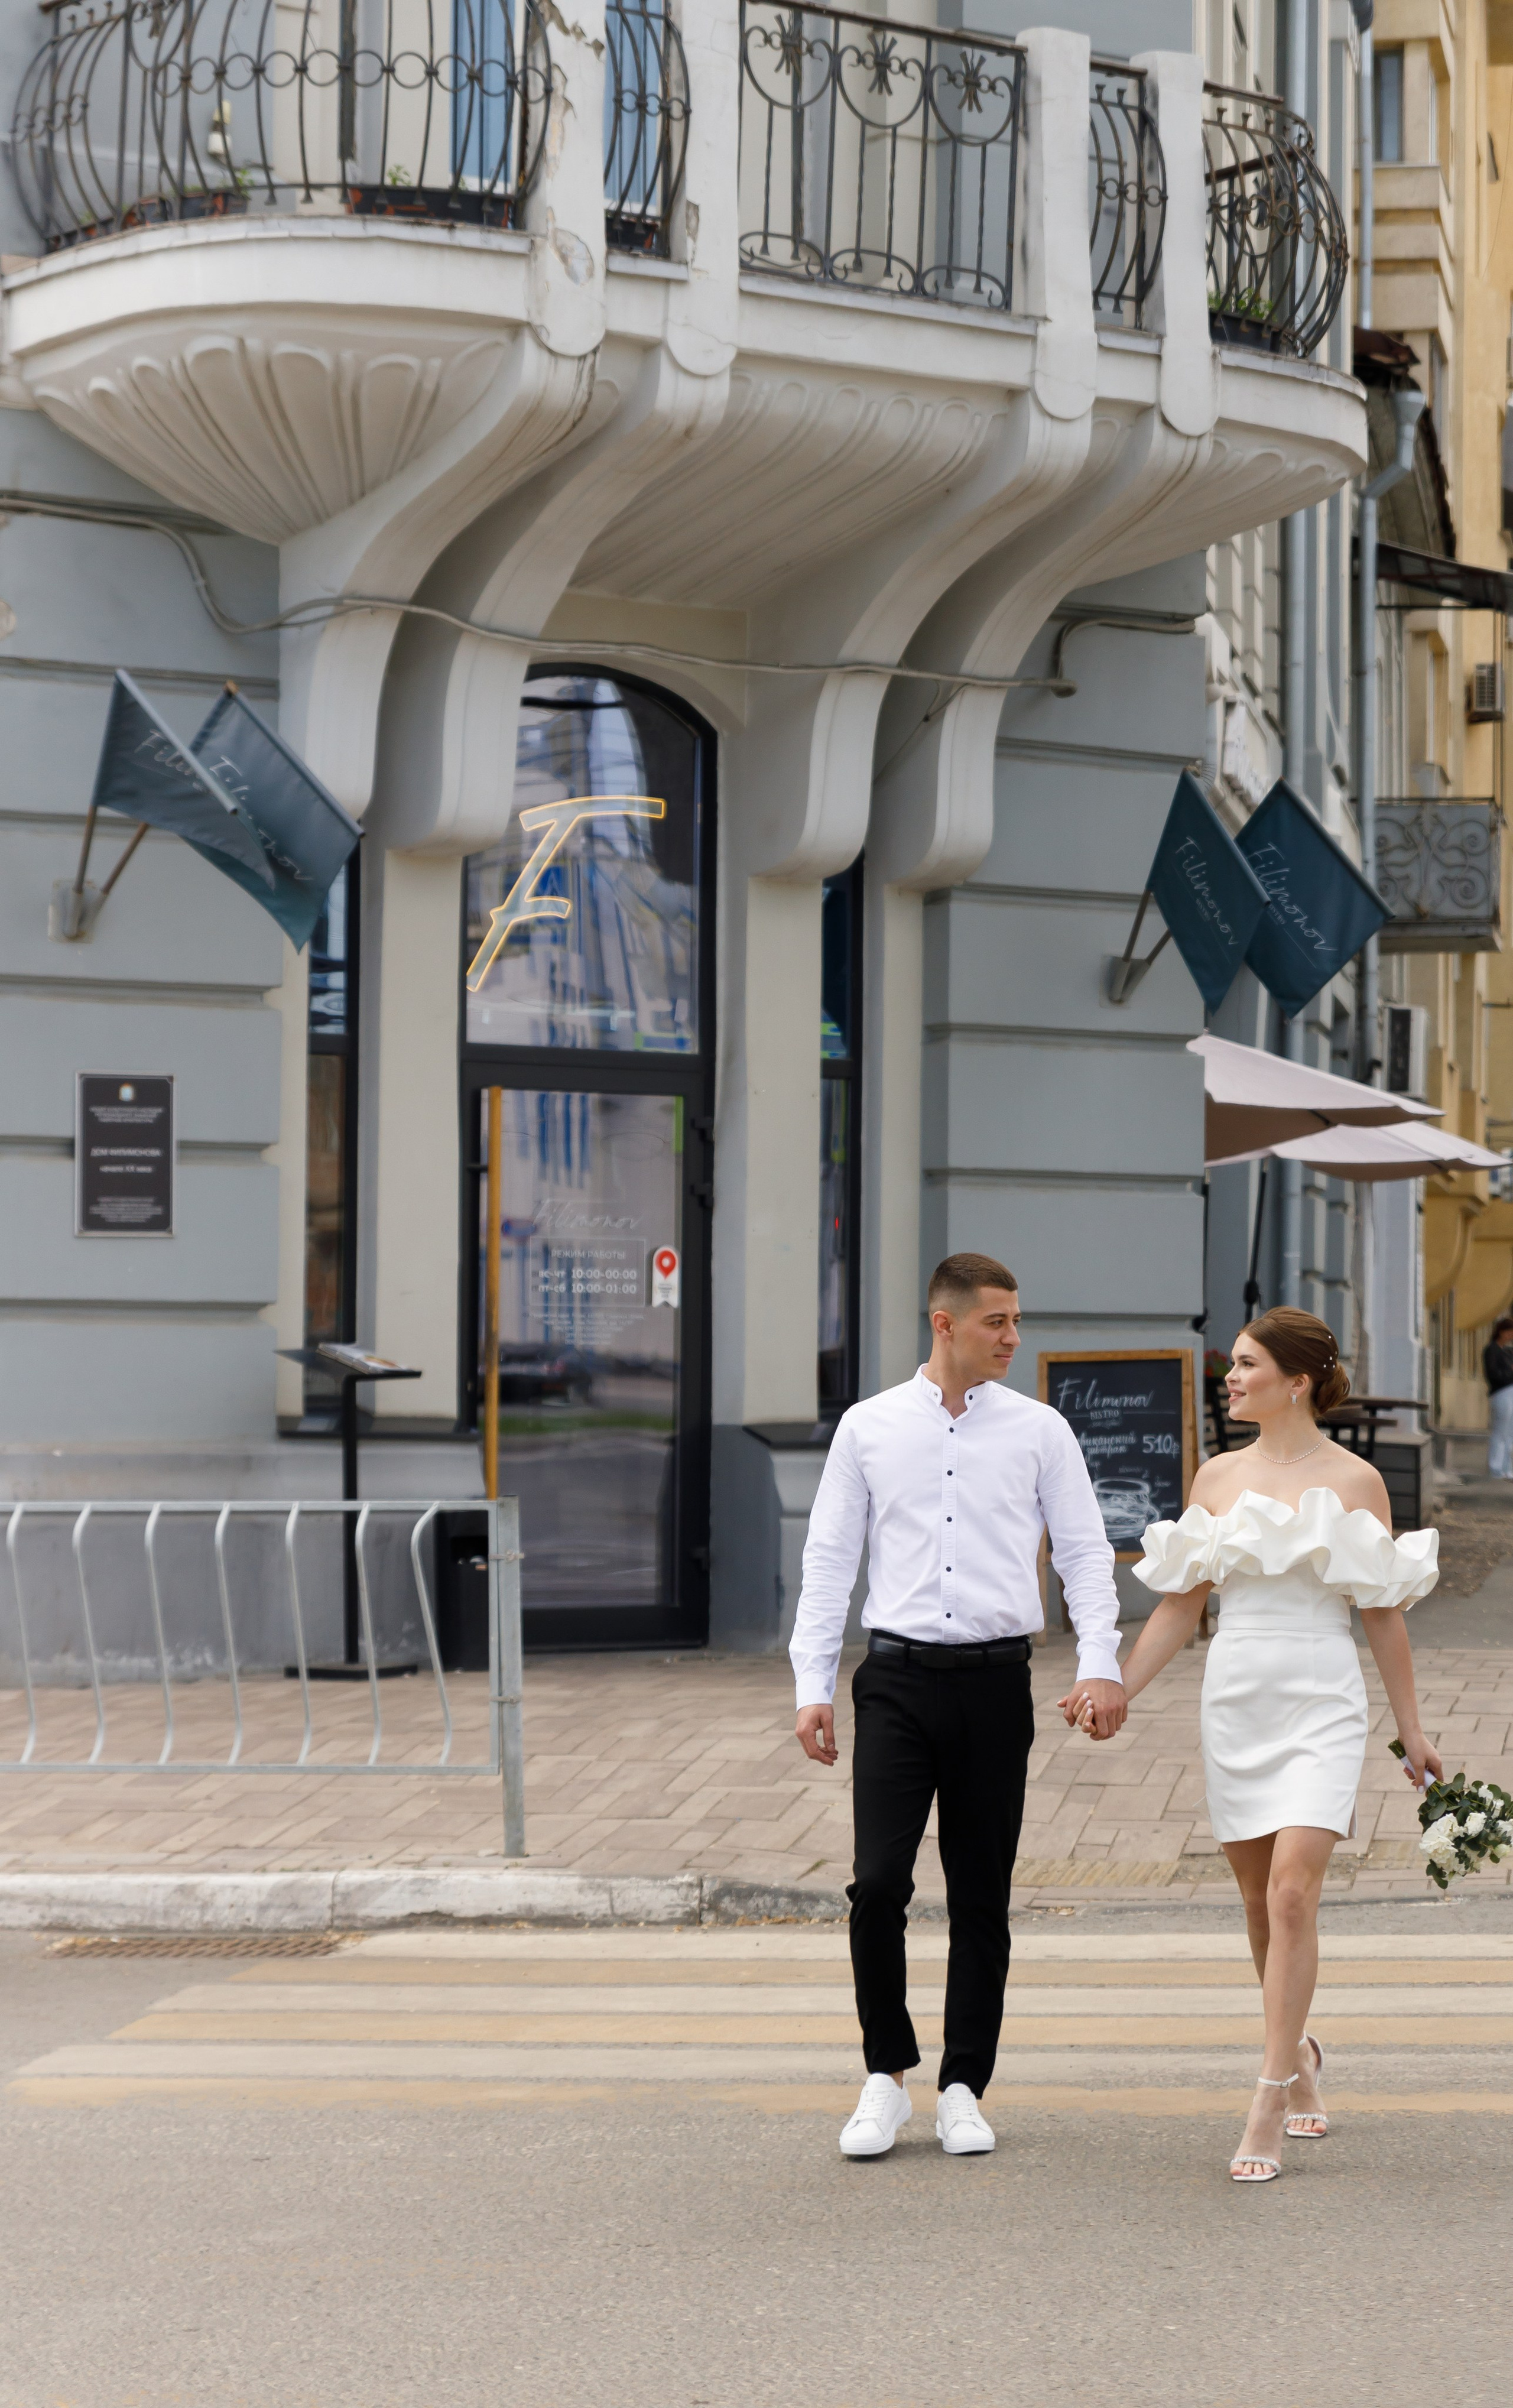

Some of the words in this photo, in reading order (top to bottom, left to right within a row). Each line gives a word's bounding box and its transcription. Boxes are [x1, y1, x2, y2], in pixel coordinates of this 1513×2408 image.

[466, 796, 666, 992] F
[1175, 836, 1239, 946] Filimonov
[1246, 842, 1339, 951] Filimonov
[533, 1198, 640, 1229] Filimonov
[551, 1250, 585, 1259] РЕЖИМ
[587, 1250, 625, 1260] РАБОТЫ
[571, 1269, 637, 1280] 10:00-00:00
[571, 1283, 637, 1294] 10:00-01:00
[1057, 1378, 1155, 1411] Filimonov
[1090, 1410, 1120, 1420] BISTRO
